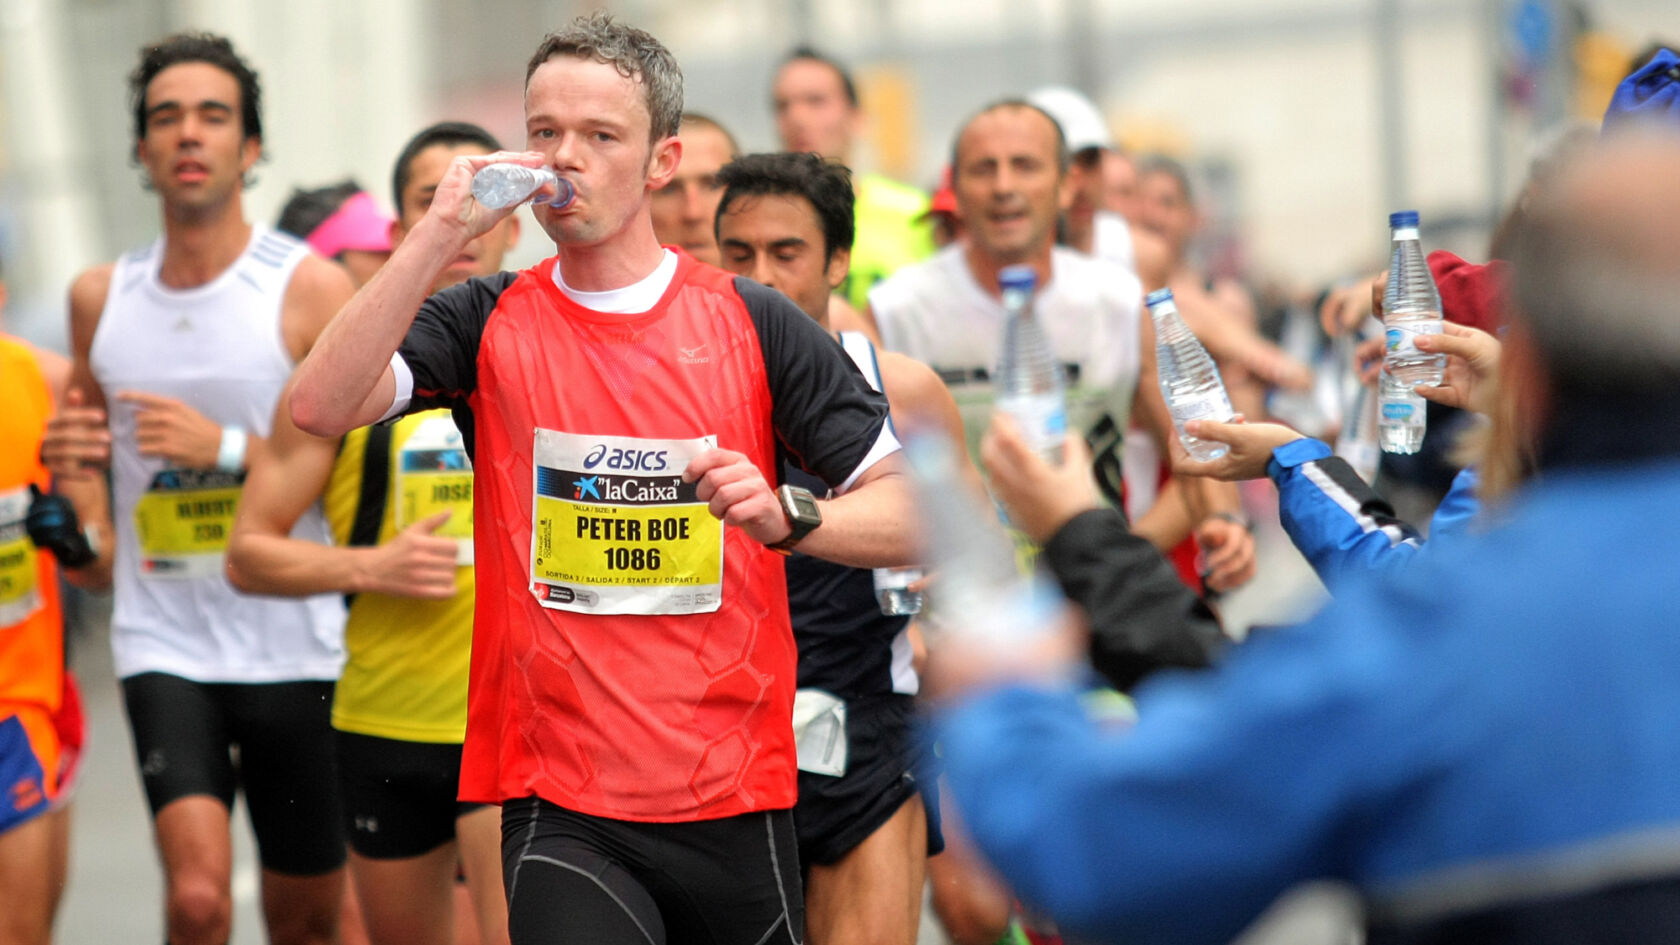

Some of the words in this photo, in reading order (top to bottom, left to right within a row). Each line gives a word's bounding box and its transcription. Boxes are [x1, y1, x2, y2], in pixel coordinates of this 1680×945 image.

[576, 515, 641, 542] PETER
[648, 517, 690, 542] BOE
[603, 547, 661, 571] 1086
[545, 569, 574, 580] SORTIDA
[586, 576, 614, 584] SALIDA
[615, 576, 620, 584] 2
[626, 576, 651, 584] START
